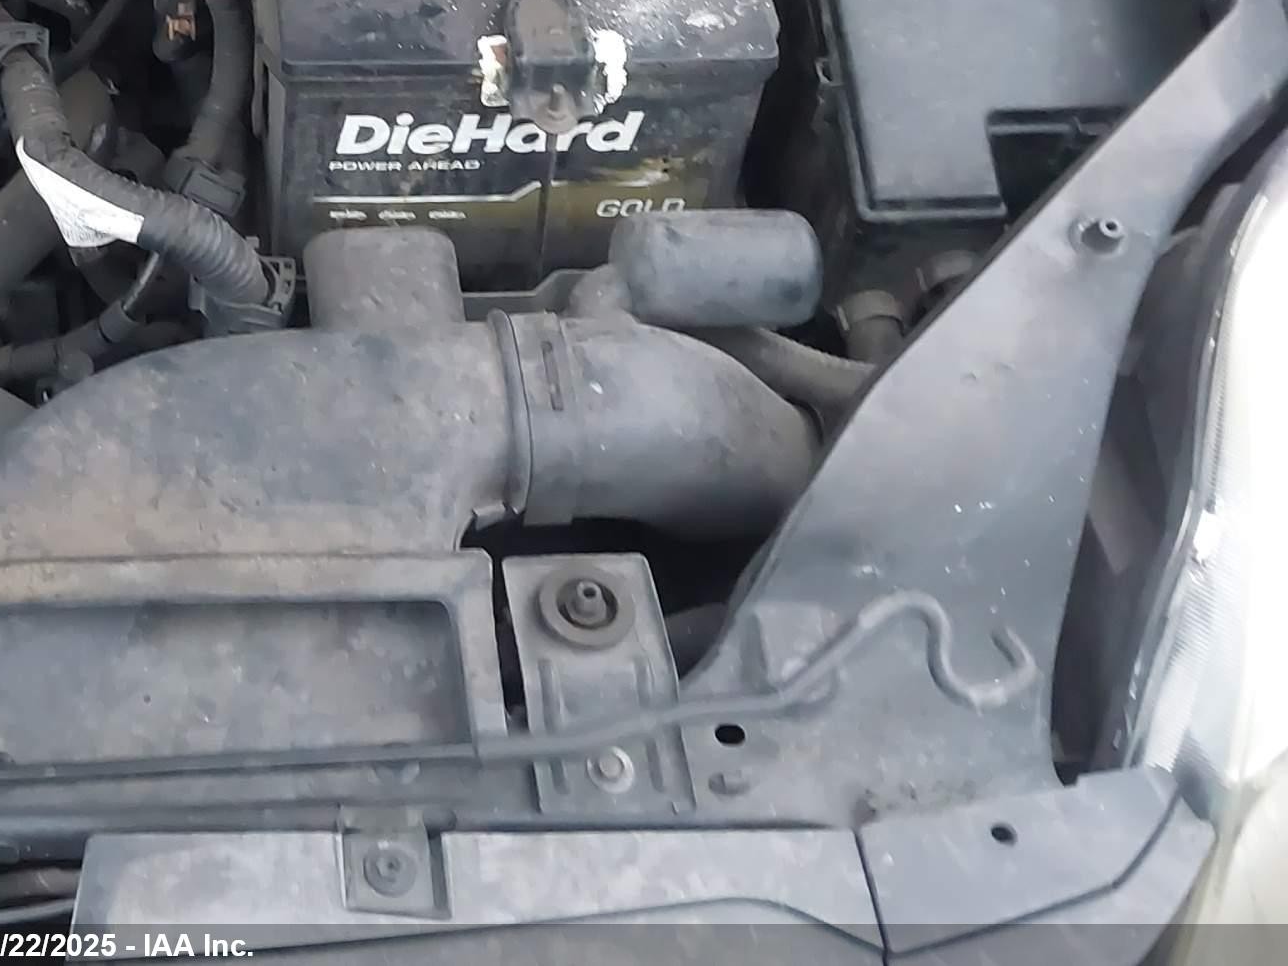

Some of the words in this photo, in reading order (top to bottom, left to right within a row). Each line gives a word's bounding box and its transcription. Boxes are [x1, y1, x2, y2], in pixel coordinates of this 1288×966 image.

[336, 111, 645, 155] DieHard
[329, 160, 402, 172] POWER
[408, 159, 480, 171] AHEAD
